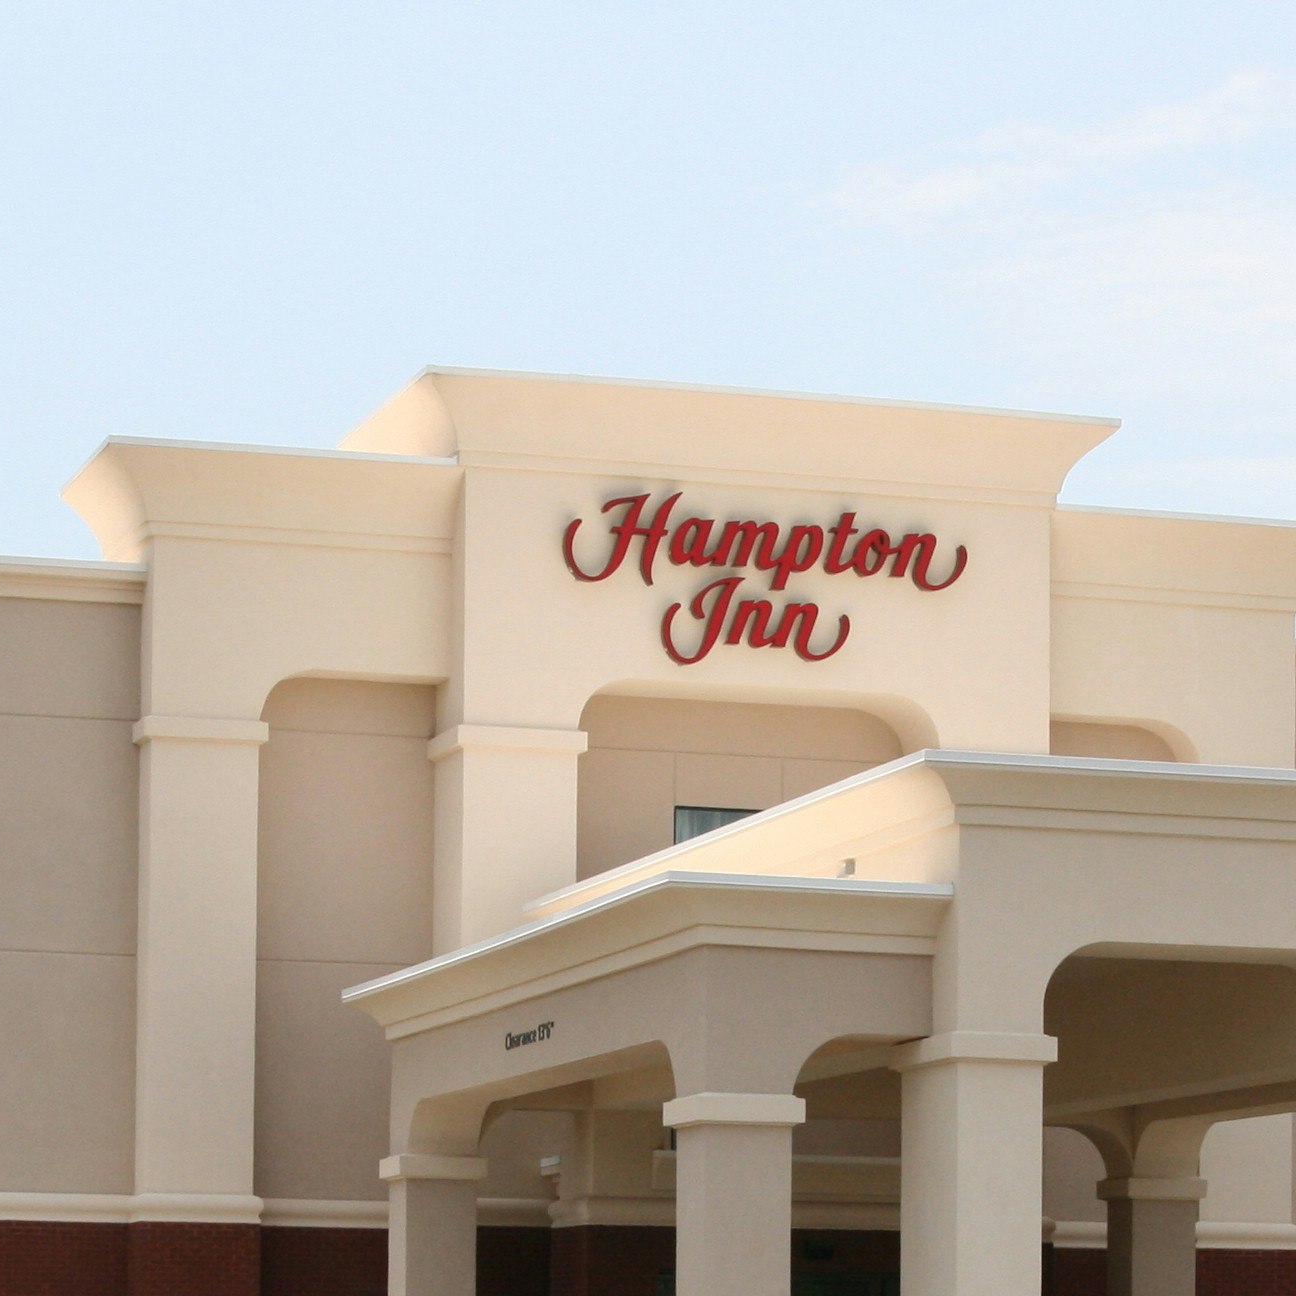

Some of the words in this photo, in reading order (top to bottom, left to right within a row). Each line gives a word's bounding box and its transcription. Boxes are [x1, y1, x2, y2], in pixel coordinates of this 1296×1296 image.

[563, 492, 968, 592] Hampton
[661, 577, 850, 665] Inn
[505, 1029, 537, 1051] Clearance
